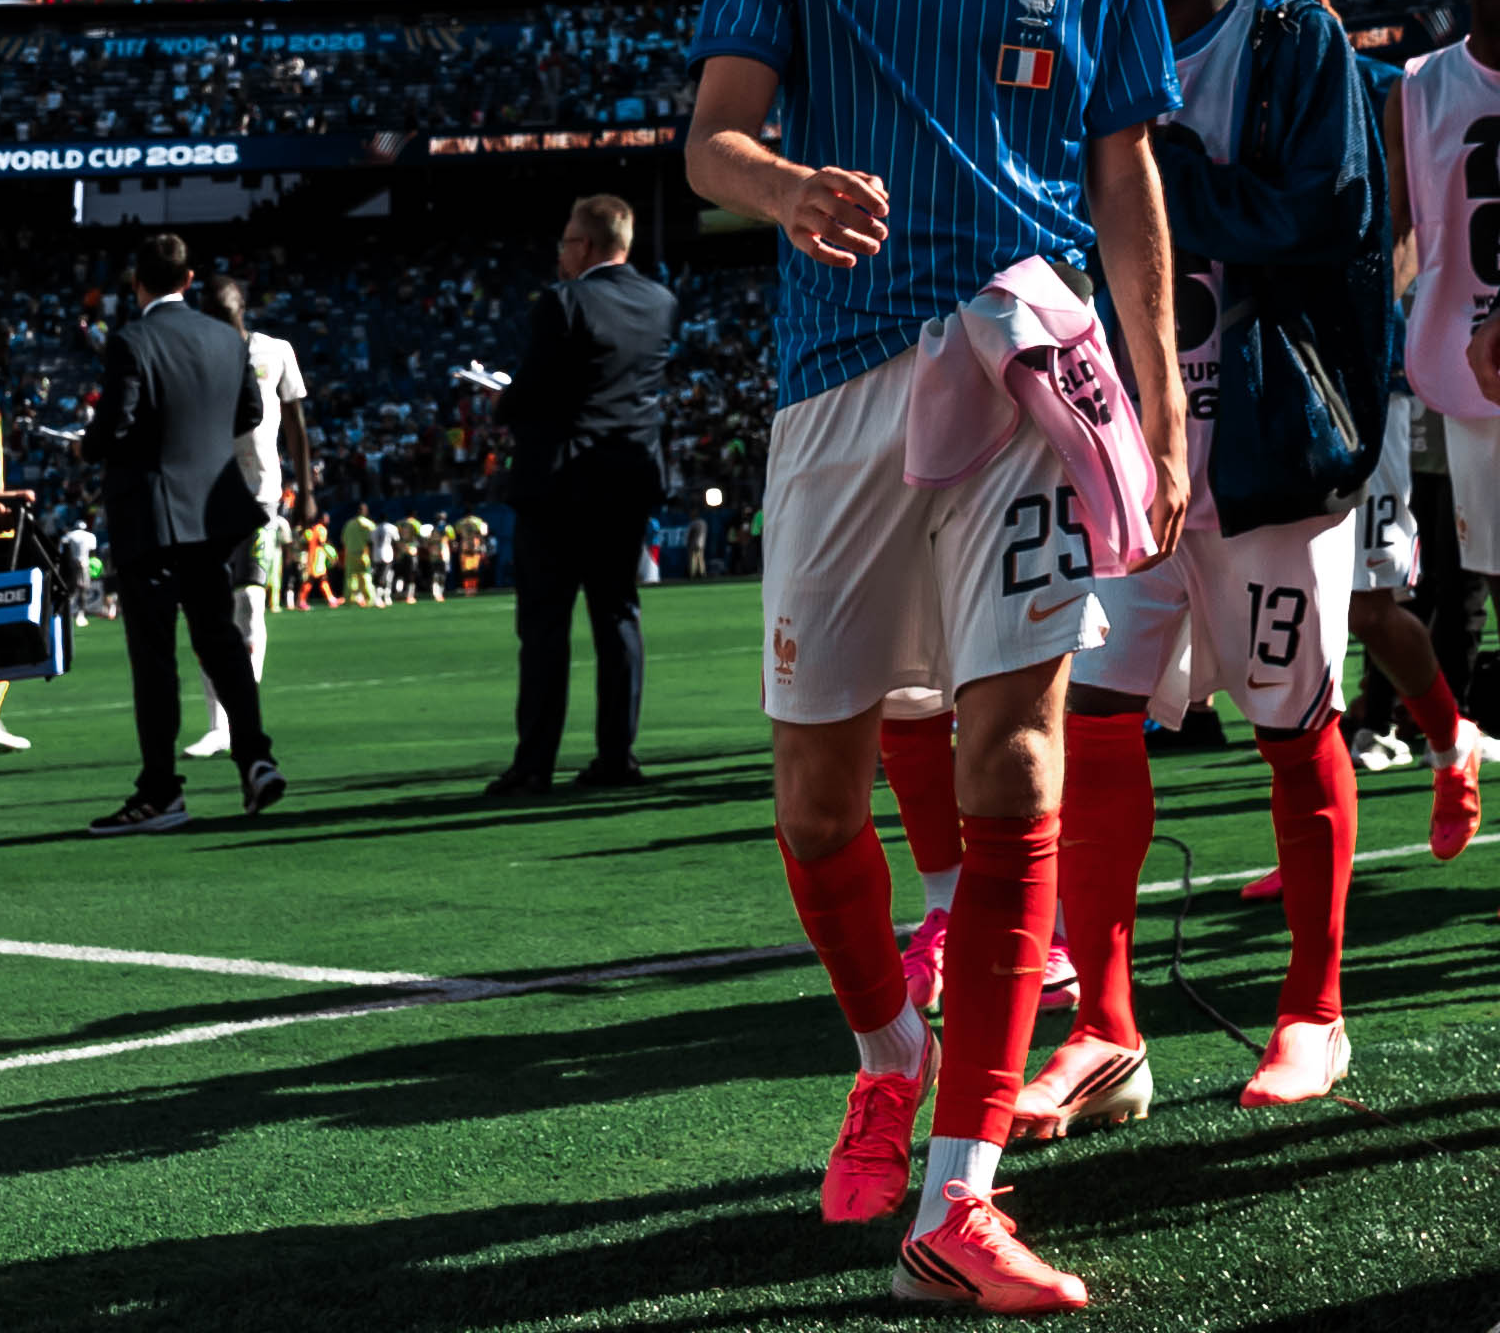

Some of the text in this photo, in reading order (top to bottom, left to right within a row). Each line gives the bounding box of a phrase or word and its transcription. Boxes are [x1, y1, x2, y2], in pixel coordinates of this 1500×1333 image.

[287, 32, 366, 52] 2026
[88, 147, 142, 168] CUP
[145, 144, 238, 166] 2026
[1002, 484, 1095, 598] 25
[1363, 493, 1397, 550] 12
[1247, 582, 1307, 668] 13
